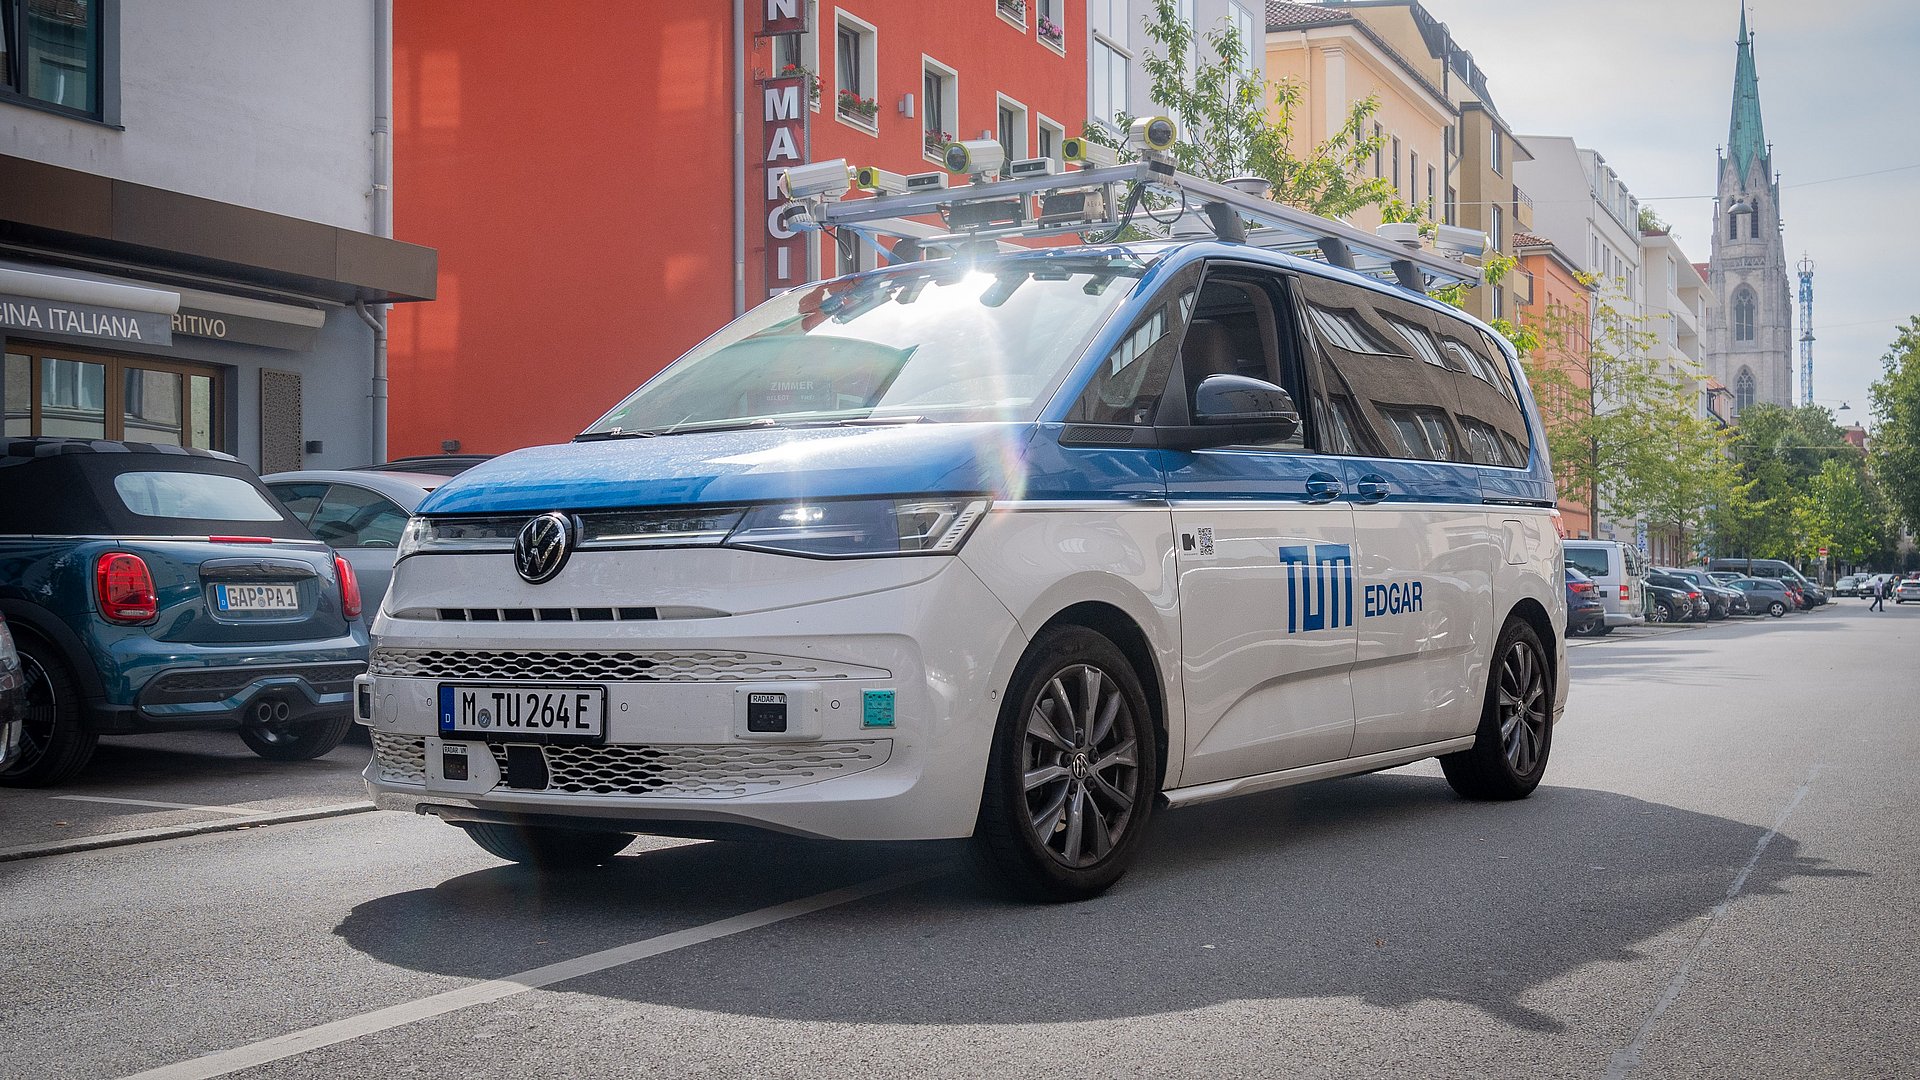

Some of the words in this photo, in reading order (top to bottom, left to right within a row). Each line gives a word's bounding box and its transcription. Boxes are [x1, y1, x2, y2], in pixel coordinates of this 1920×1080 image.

[765, 86, 803, 297] MAGI
[0, 302, 42, 328] INA
[48, 308, 141, 340] ITALIANA
[171, 313, 226, 338] RITIVO
[770, 381, 814, 391] ZIMMER
[227, 587, 257, 607] GAP
[1279, 544, 1353, 633] TUM
[1364, 581, 1423, 618] EDGAR
[445, 713, 450, 723] D
[462, 692, 476, 726] M
[752, 695, 775, 703] RADAR
[444, 746, 459, 754] RADAR
